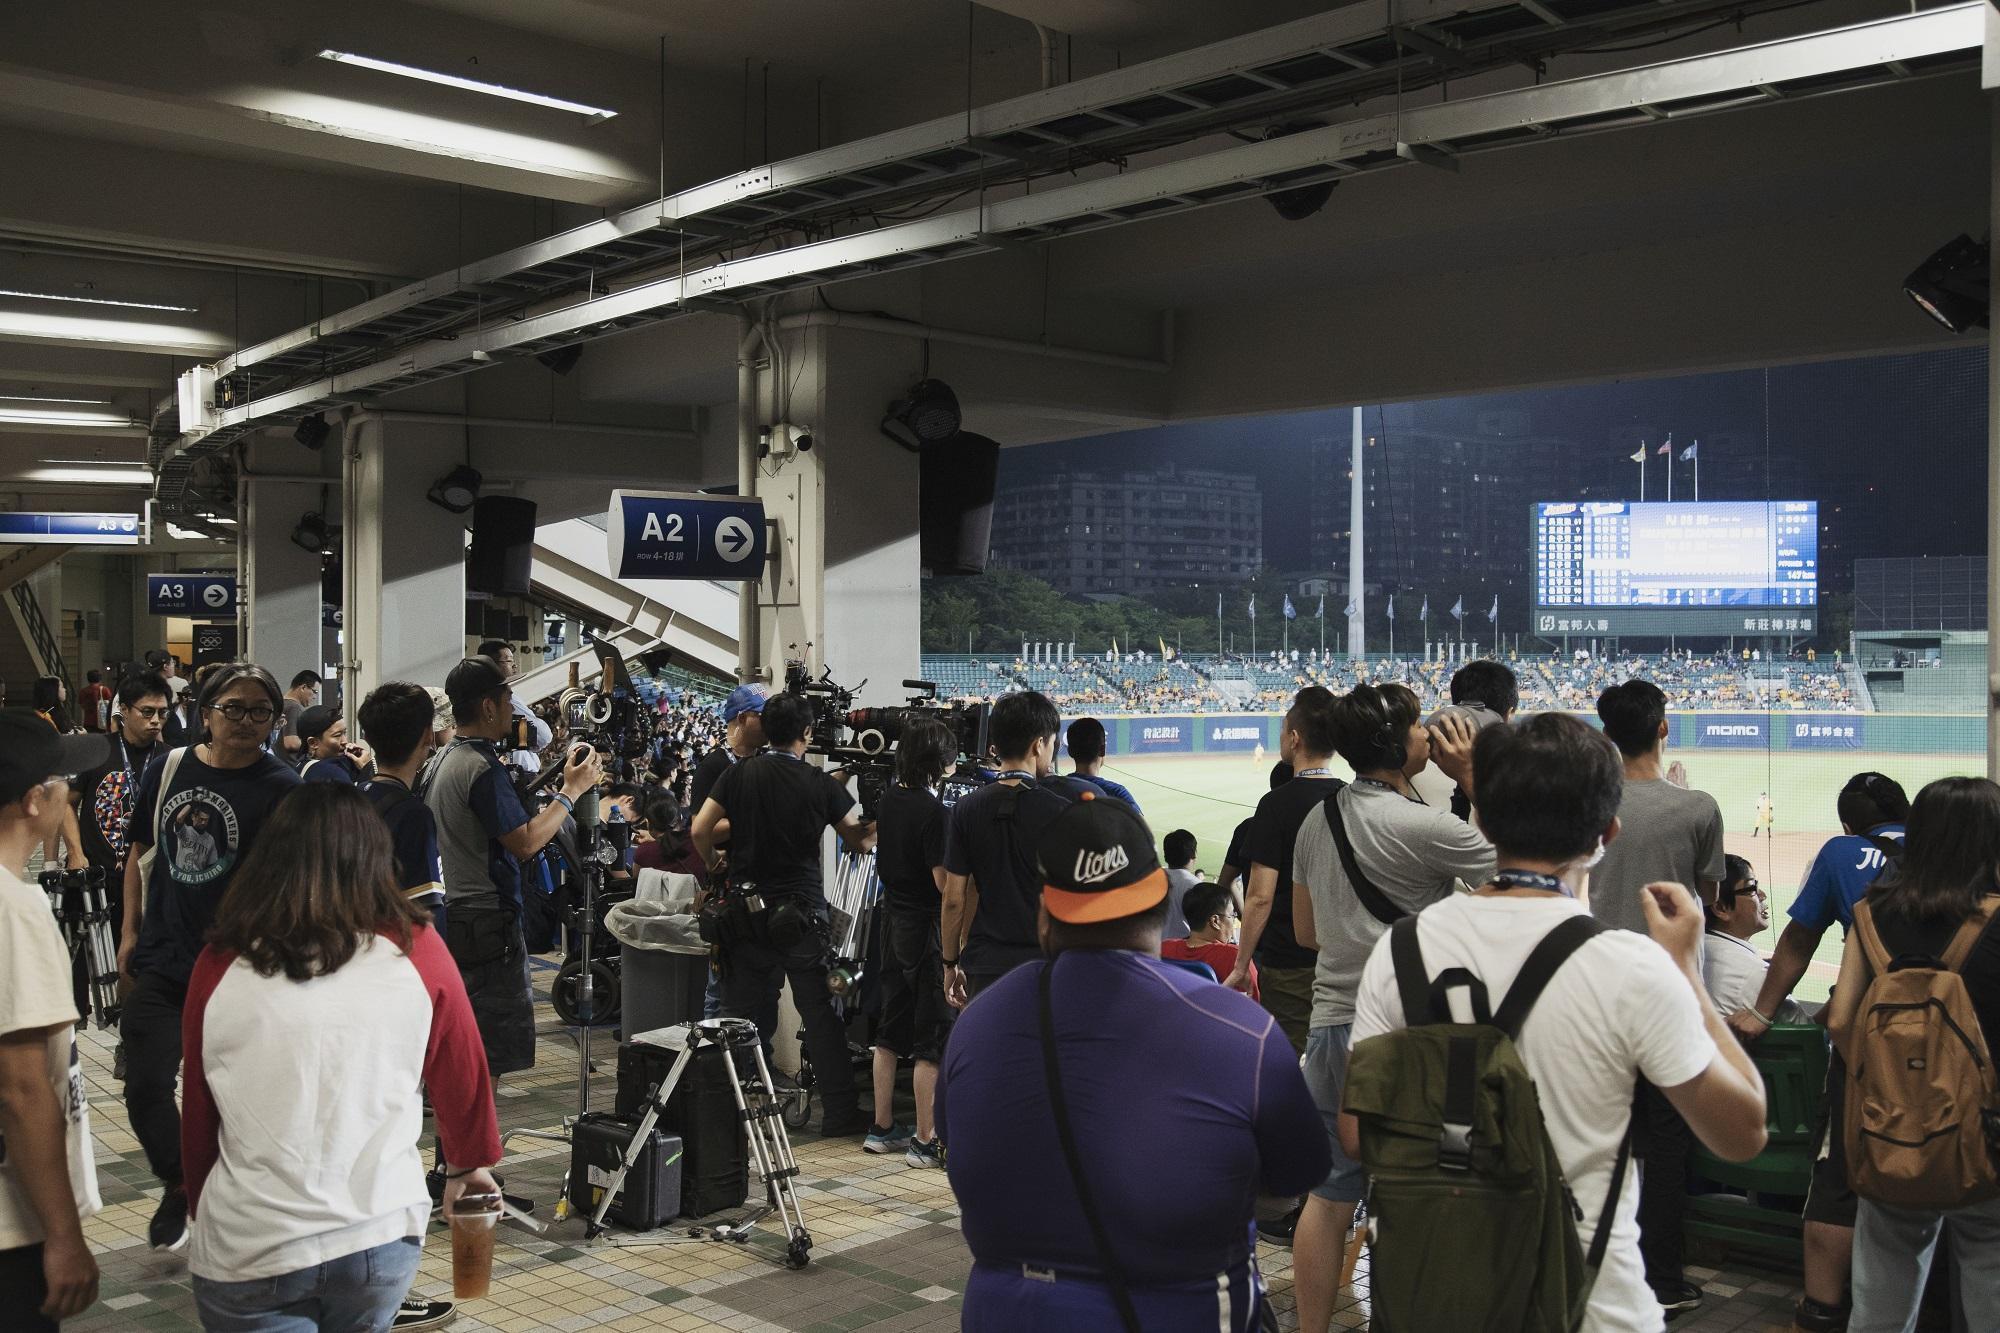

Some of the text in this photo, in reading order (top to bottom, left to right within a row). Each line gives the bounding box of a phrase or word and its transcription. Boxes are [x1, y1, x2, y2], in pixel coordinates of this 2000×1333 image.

[97, 519, 117, 531] A3
[641, 512, 684, 542] A2
[158, 583, 185, 599] A3
[1706, 725, 1759, 736] momo
[210, 793, 237, 843] MARINERS
[1074, 844, 1130, 883] Lions
